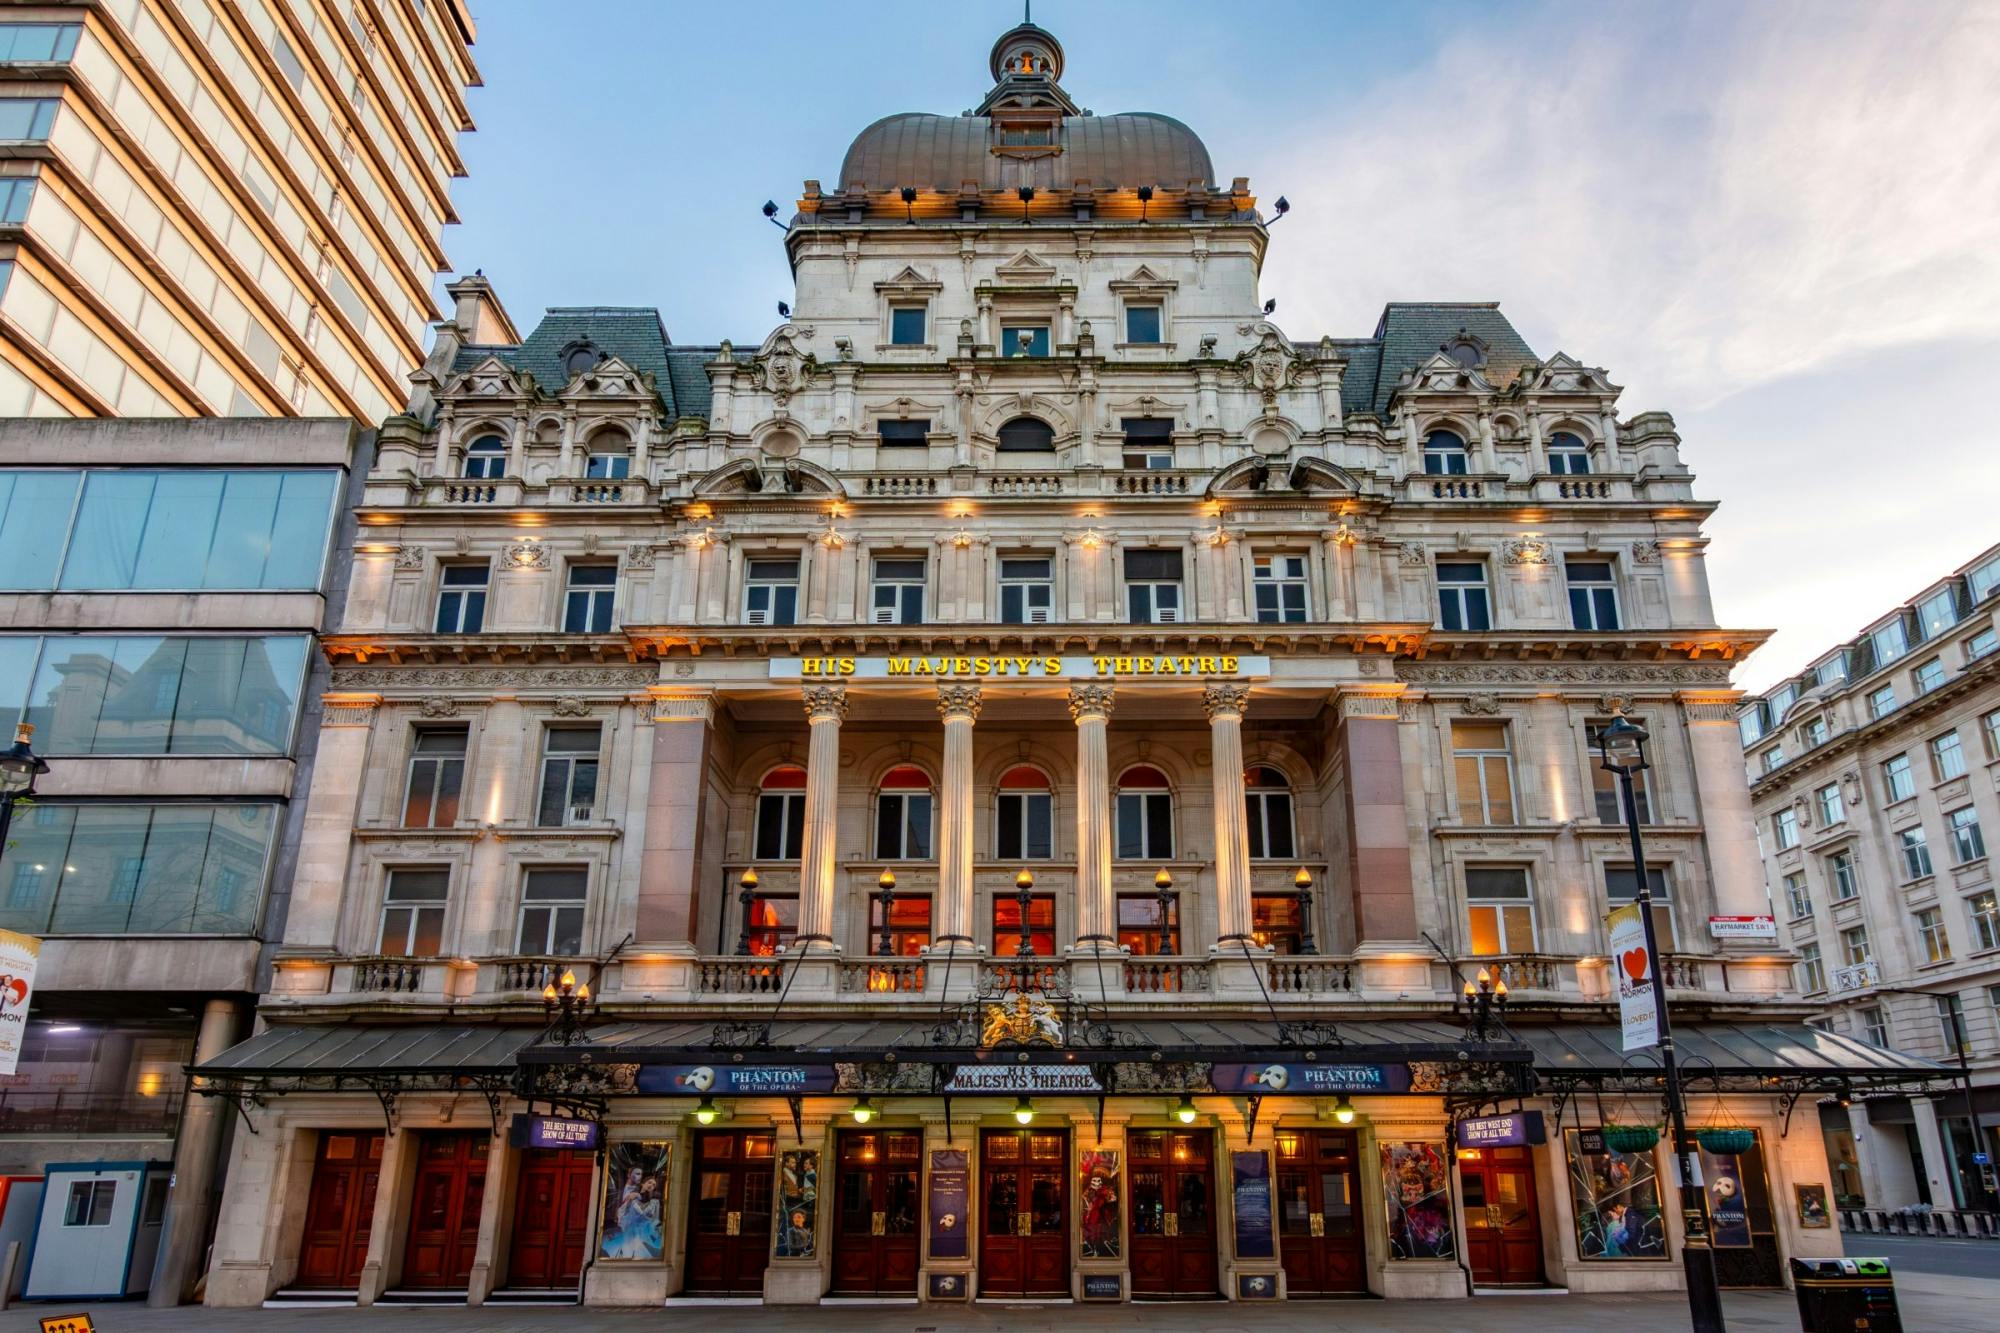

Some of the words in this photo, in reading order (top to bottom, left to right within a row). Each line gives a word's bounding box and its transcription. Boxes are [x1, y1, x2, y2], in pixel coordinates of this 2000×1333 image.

[802, 657, 856, 675] HIS
[888, 656, 1061, 675] MAJESTY'S
[1093, 656, 1239, 674] THEATRE
[1621, 985, 1653, 1000] MORMON
[1627, 1013, 1648, 1025] LOVED
[730, 1070, 806, 1083] PHANTOM
[1008, 1066, 1038, 1075] HIS
[1304, 1069, 1381, 1082] PHANTOM
[1031, 1074, 1093, 1088] THEATRE
[543, 1120, 553, 1130] THE
[554, 1122, 565, 1131] BEST
[566, 1123, 578, 1132] WEST
[1476, 1121, 1487, 1130] BEST
[1488, 1120, 1500, 1129] WEST
[1501, 1118, 1513, 1128] END
[542, 1130, 557, 1139] SHOW
[557, 1131, 565, 1140] OF
[565, 1131, 575, 1140] ALL
[575, 1132, 588, 1141] TIME
[1467, 1130, 1480, 1140] SHOW
[1481, 1129, 1488, 1138] OF
[1488, 1128, 1498, 1137] ALL
[1498, 1127, 1512, 1137] TIME
